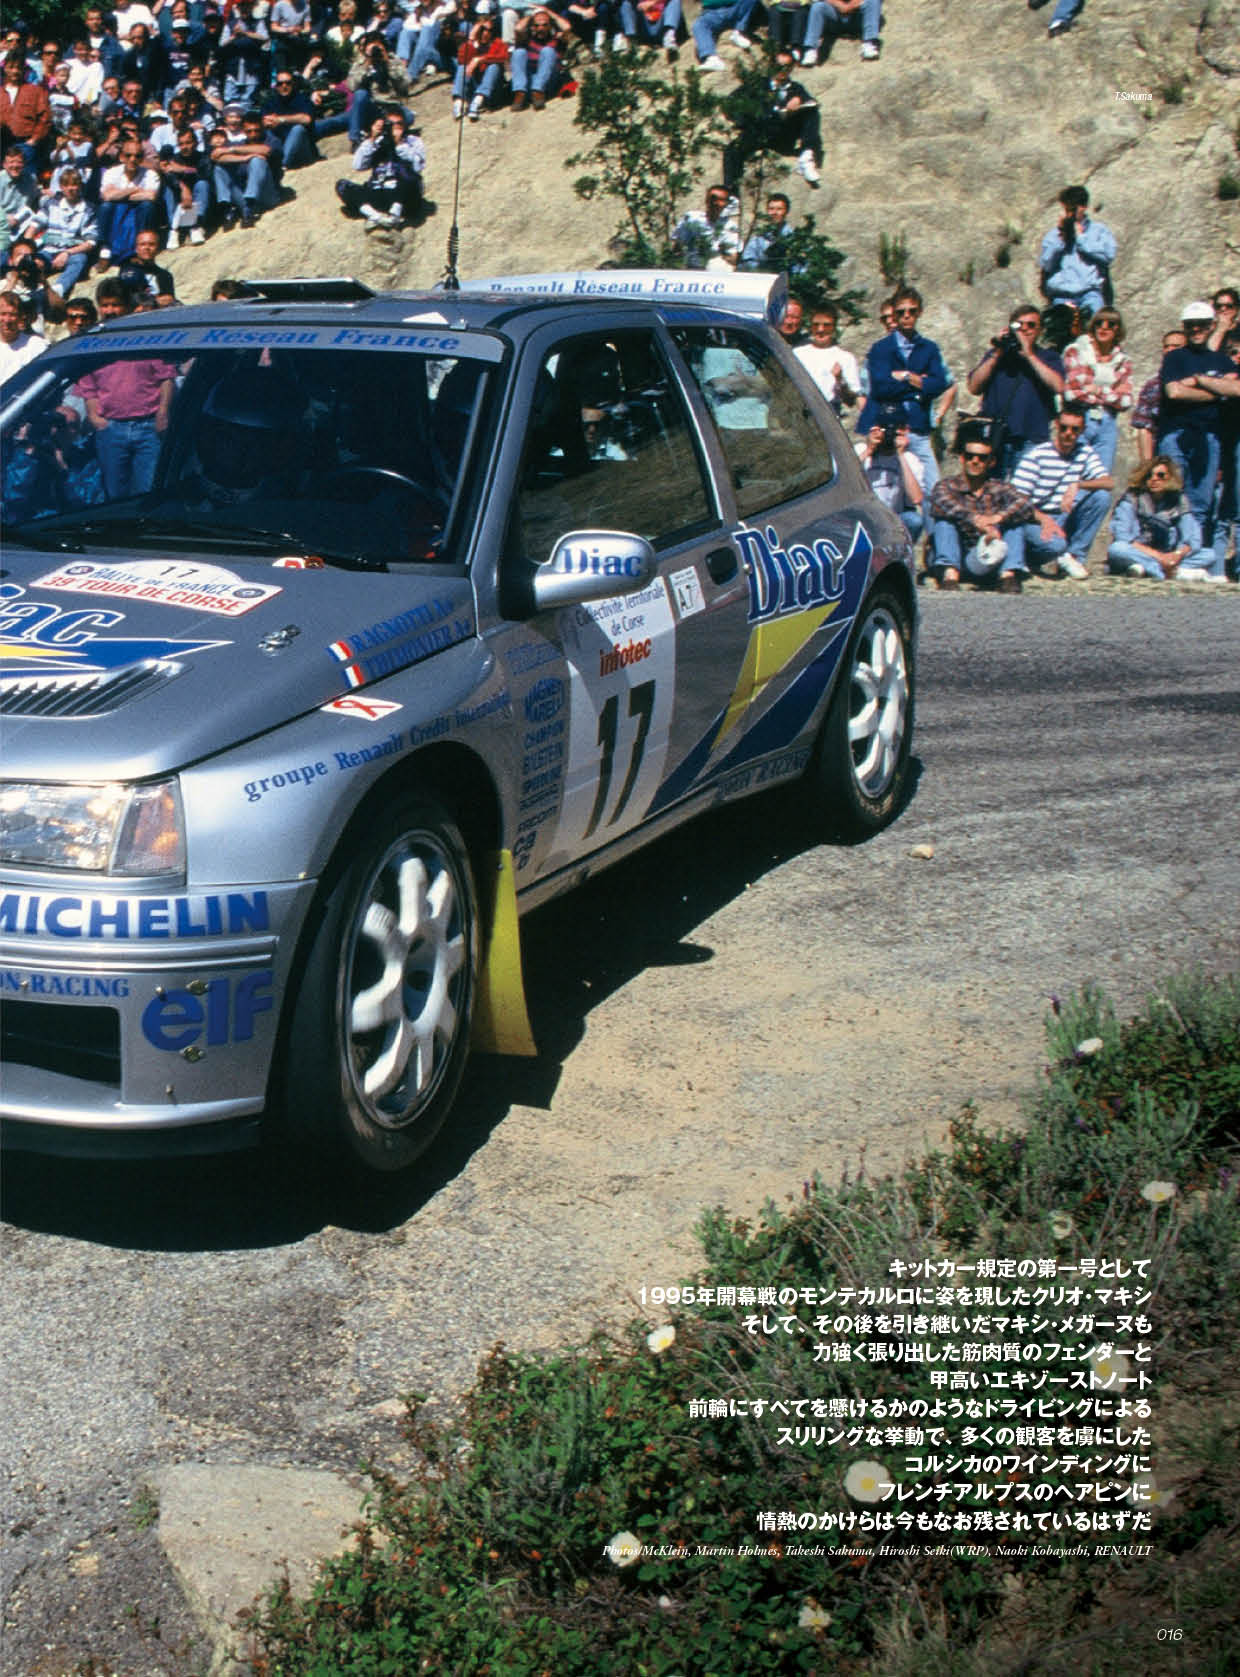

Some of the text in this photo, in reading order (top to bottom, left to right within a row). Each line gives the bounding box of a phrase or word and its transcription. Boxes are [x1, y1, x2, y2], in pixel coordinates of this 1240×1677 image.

[651, 279, 726, 294] France
[331, 329, 461, 351] France
[159, 566, 198, 578] 17
[558, 548, 641, 576] Diac
[732, 524, 845, 625] Diac
[78, 579, 138, 595] TOUR
[136, 586, 170, 598] DE
[166, 591, 245, 612] CORSE
[166, 581, 234, 596] FRANCE
[622, 614, 646, 632] Corse
[599, 637, 653, 678] infotec
[244, 758, 329, 802] groupe
[333, 734, 406, 771] Renault
[582, 679, 657, 841] 17
[28, 973, 130, 998] RACING
[141, 968, 275, 1052] elf
